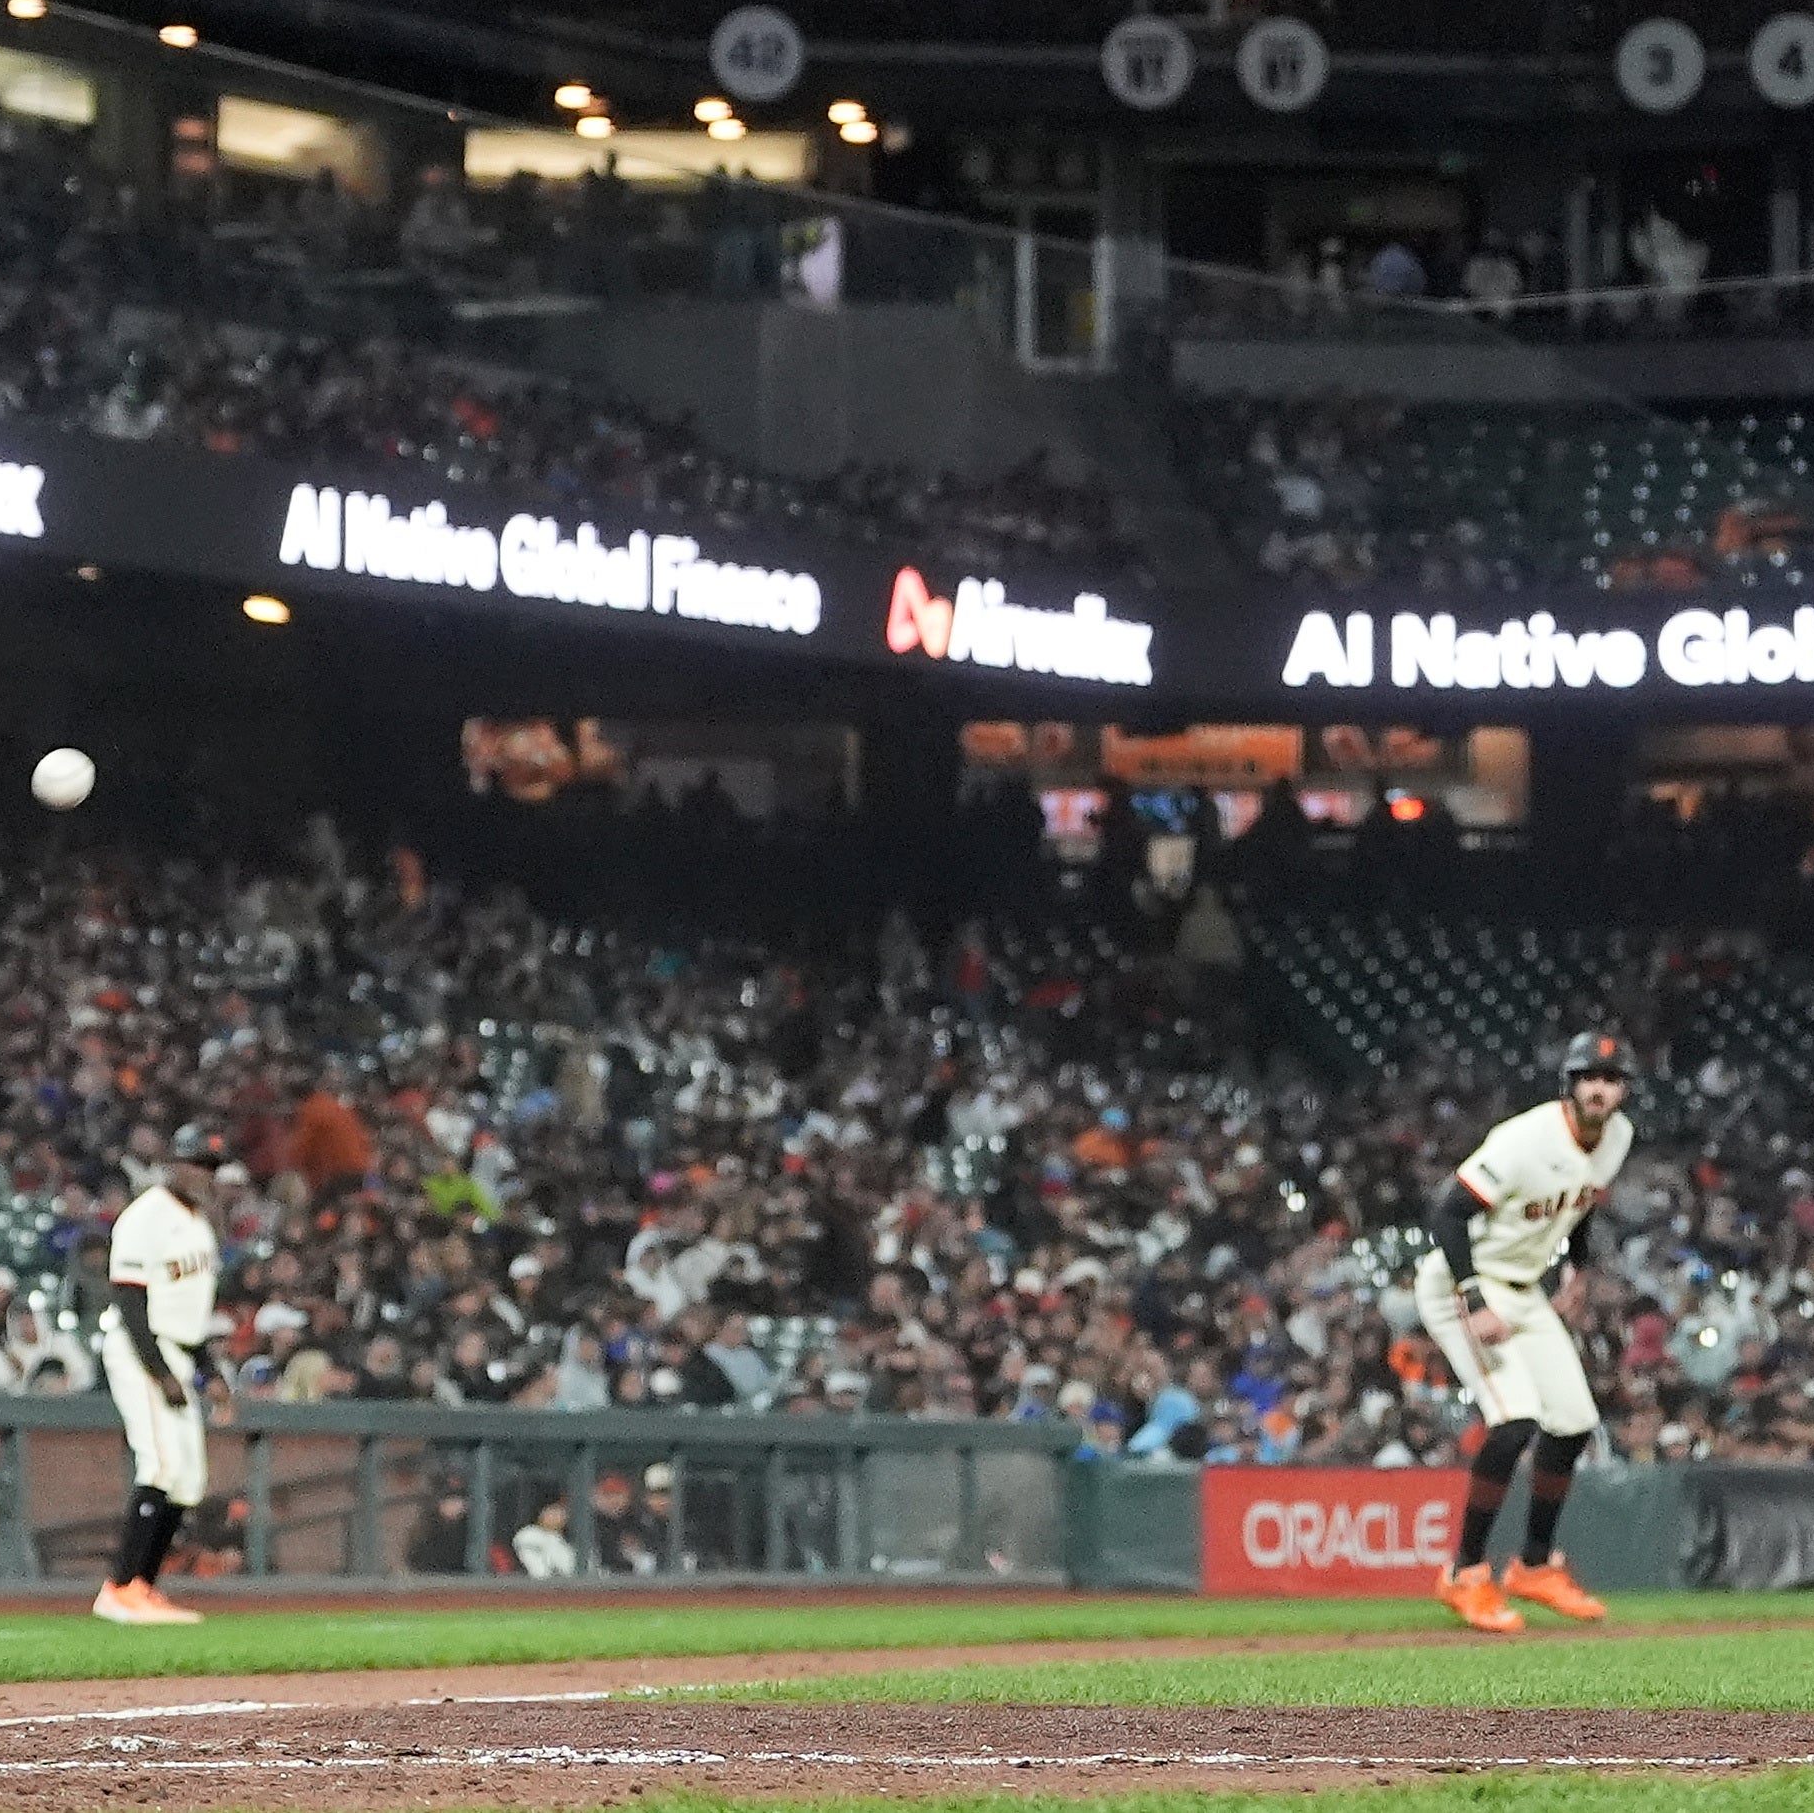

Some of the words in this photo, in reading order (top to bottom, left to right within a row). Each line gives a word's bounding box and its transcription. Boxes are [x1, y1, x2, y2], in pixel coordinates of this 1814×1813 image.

[1778, 44, 1803, 84] 4
[278, 482, 342, 571] AI
[344, 489, 498, 590] Native
[499, 513, 651, 611] Global
[652, 534, 822, 634] Finance
[1282, 611, 1374, 686] AI
[1391, 611, 1647, 688] Native
[1243, 1501, 1452, 1568] ORACLE
